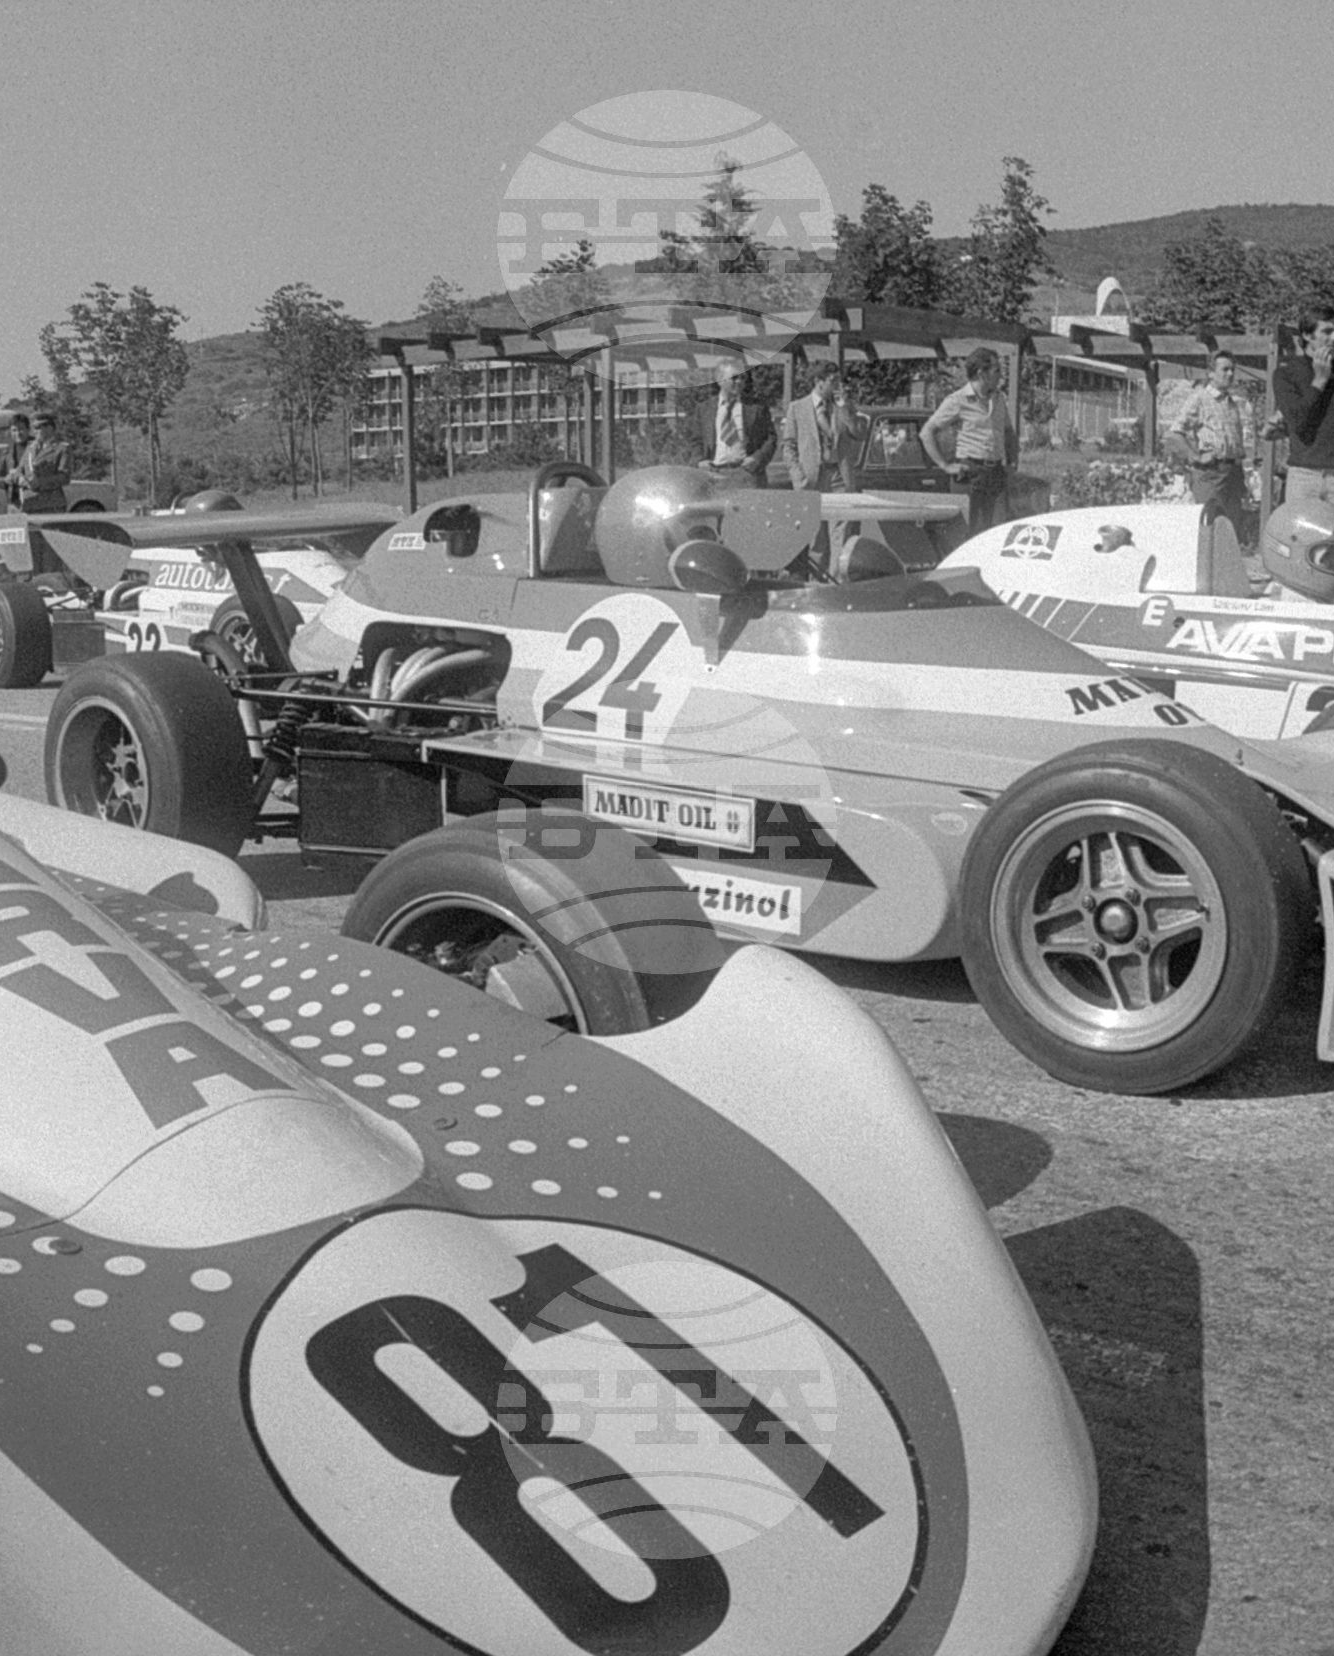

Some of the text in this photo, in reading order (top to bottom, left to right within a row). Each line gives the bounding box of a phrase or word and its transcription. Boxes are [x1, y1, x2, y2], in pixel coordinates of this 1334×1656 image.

[1142, 598, 1168, 626] E
[1167, 619, 1286, 661] AVIA
[542, 617, 680, 740] 24
[594, 790, 717, 831] MADIT OIL
[304, 1242, 886, 1656] 81
